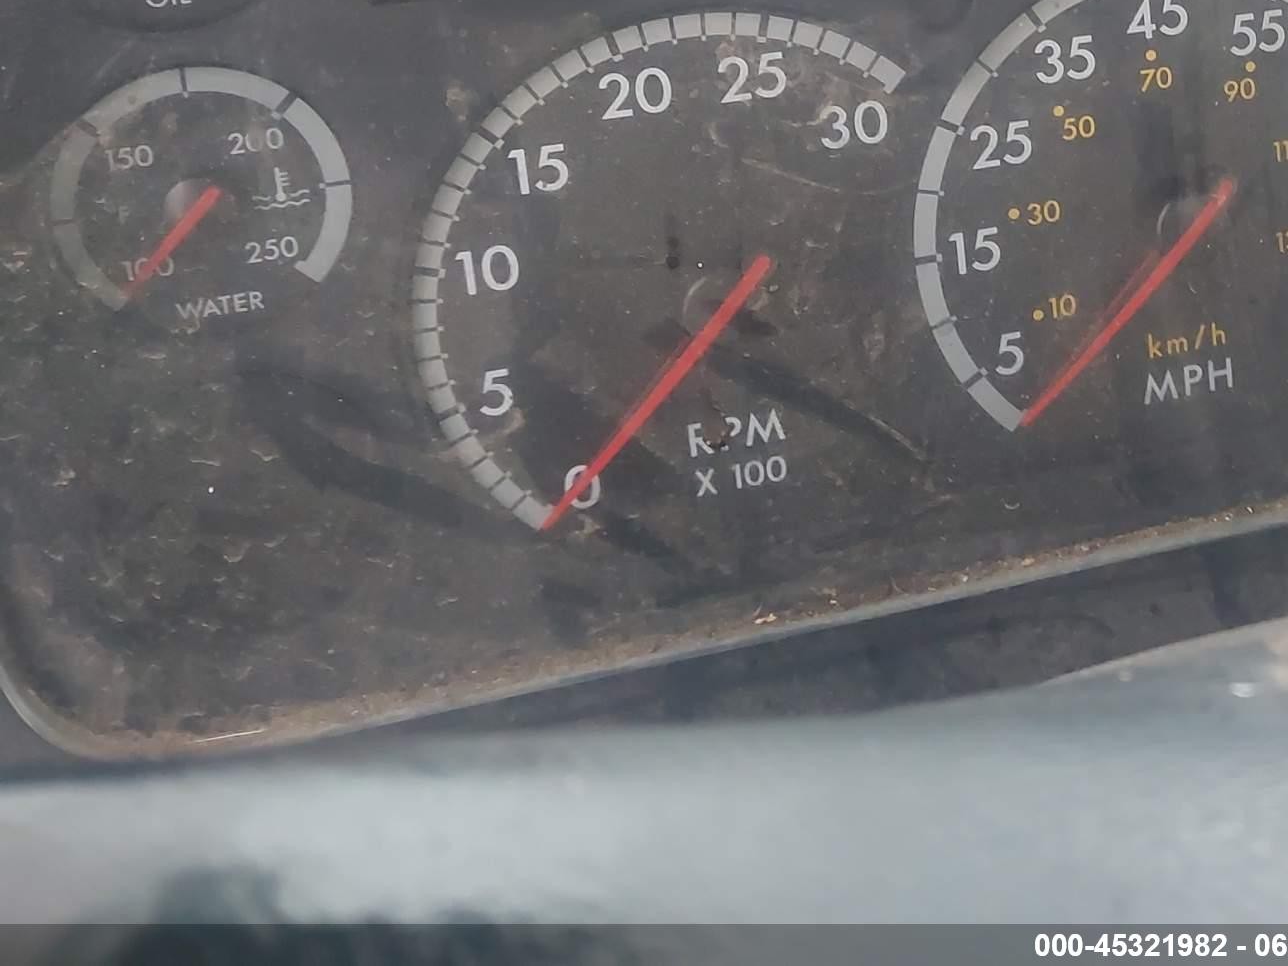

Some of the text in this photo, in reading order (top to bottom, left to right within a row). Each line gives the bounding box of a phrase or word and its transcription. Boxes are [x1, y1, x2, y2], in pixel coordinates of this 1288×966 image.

[1230, 9, 1285, 56] 55
[717, 52, 787, 103] 25
[1034, 35, 1095, 84] 35
[1140, 66, 1172, 93] 70
[599, 67, 672, 120] 20
[1224, 77, 1256, 102] 90
[820, 100, 888, 149] 30
[970, 120, 1032, 170] 25
[1062, 115, 1095, 140] 50
[105, 145, 154, 171] 150
[507, 143, 569, 195] 15
[1027, 200, 1060, 225] 30
[244, 236, 299, 264] 250
[455, 245, 519, 295] 10
[948, 227, 1001, 274] 15
[175, 291, 265, 320] WATER
[1048, 294, 1076, 318] 10
[995, 331, 1024, 375] 5
[1148, 323, 1227, 359] km/h
[479, 368, 513, 416] 5
[1144, 358, 1234, 405] MPH
[564, 464, 600, 509] 0
[732, 455, 787, 489] 100
